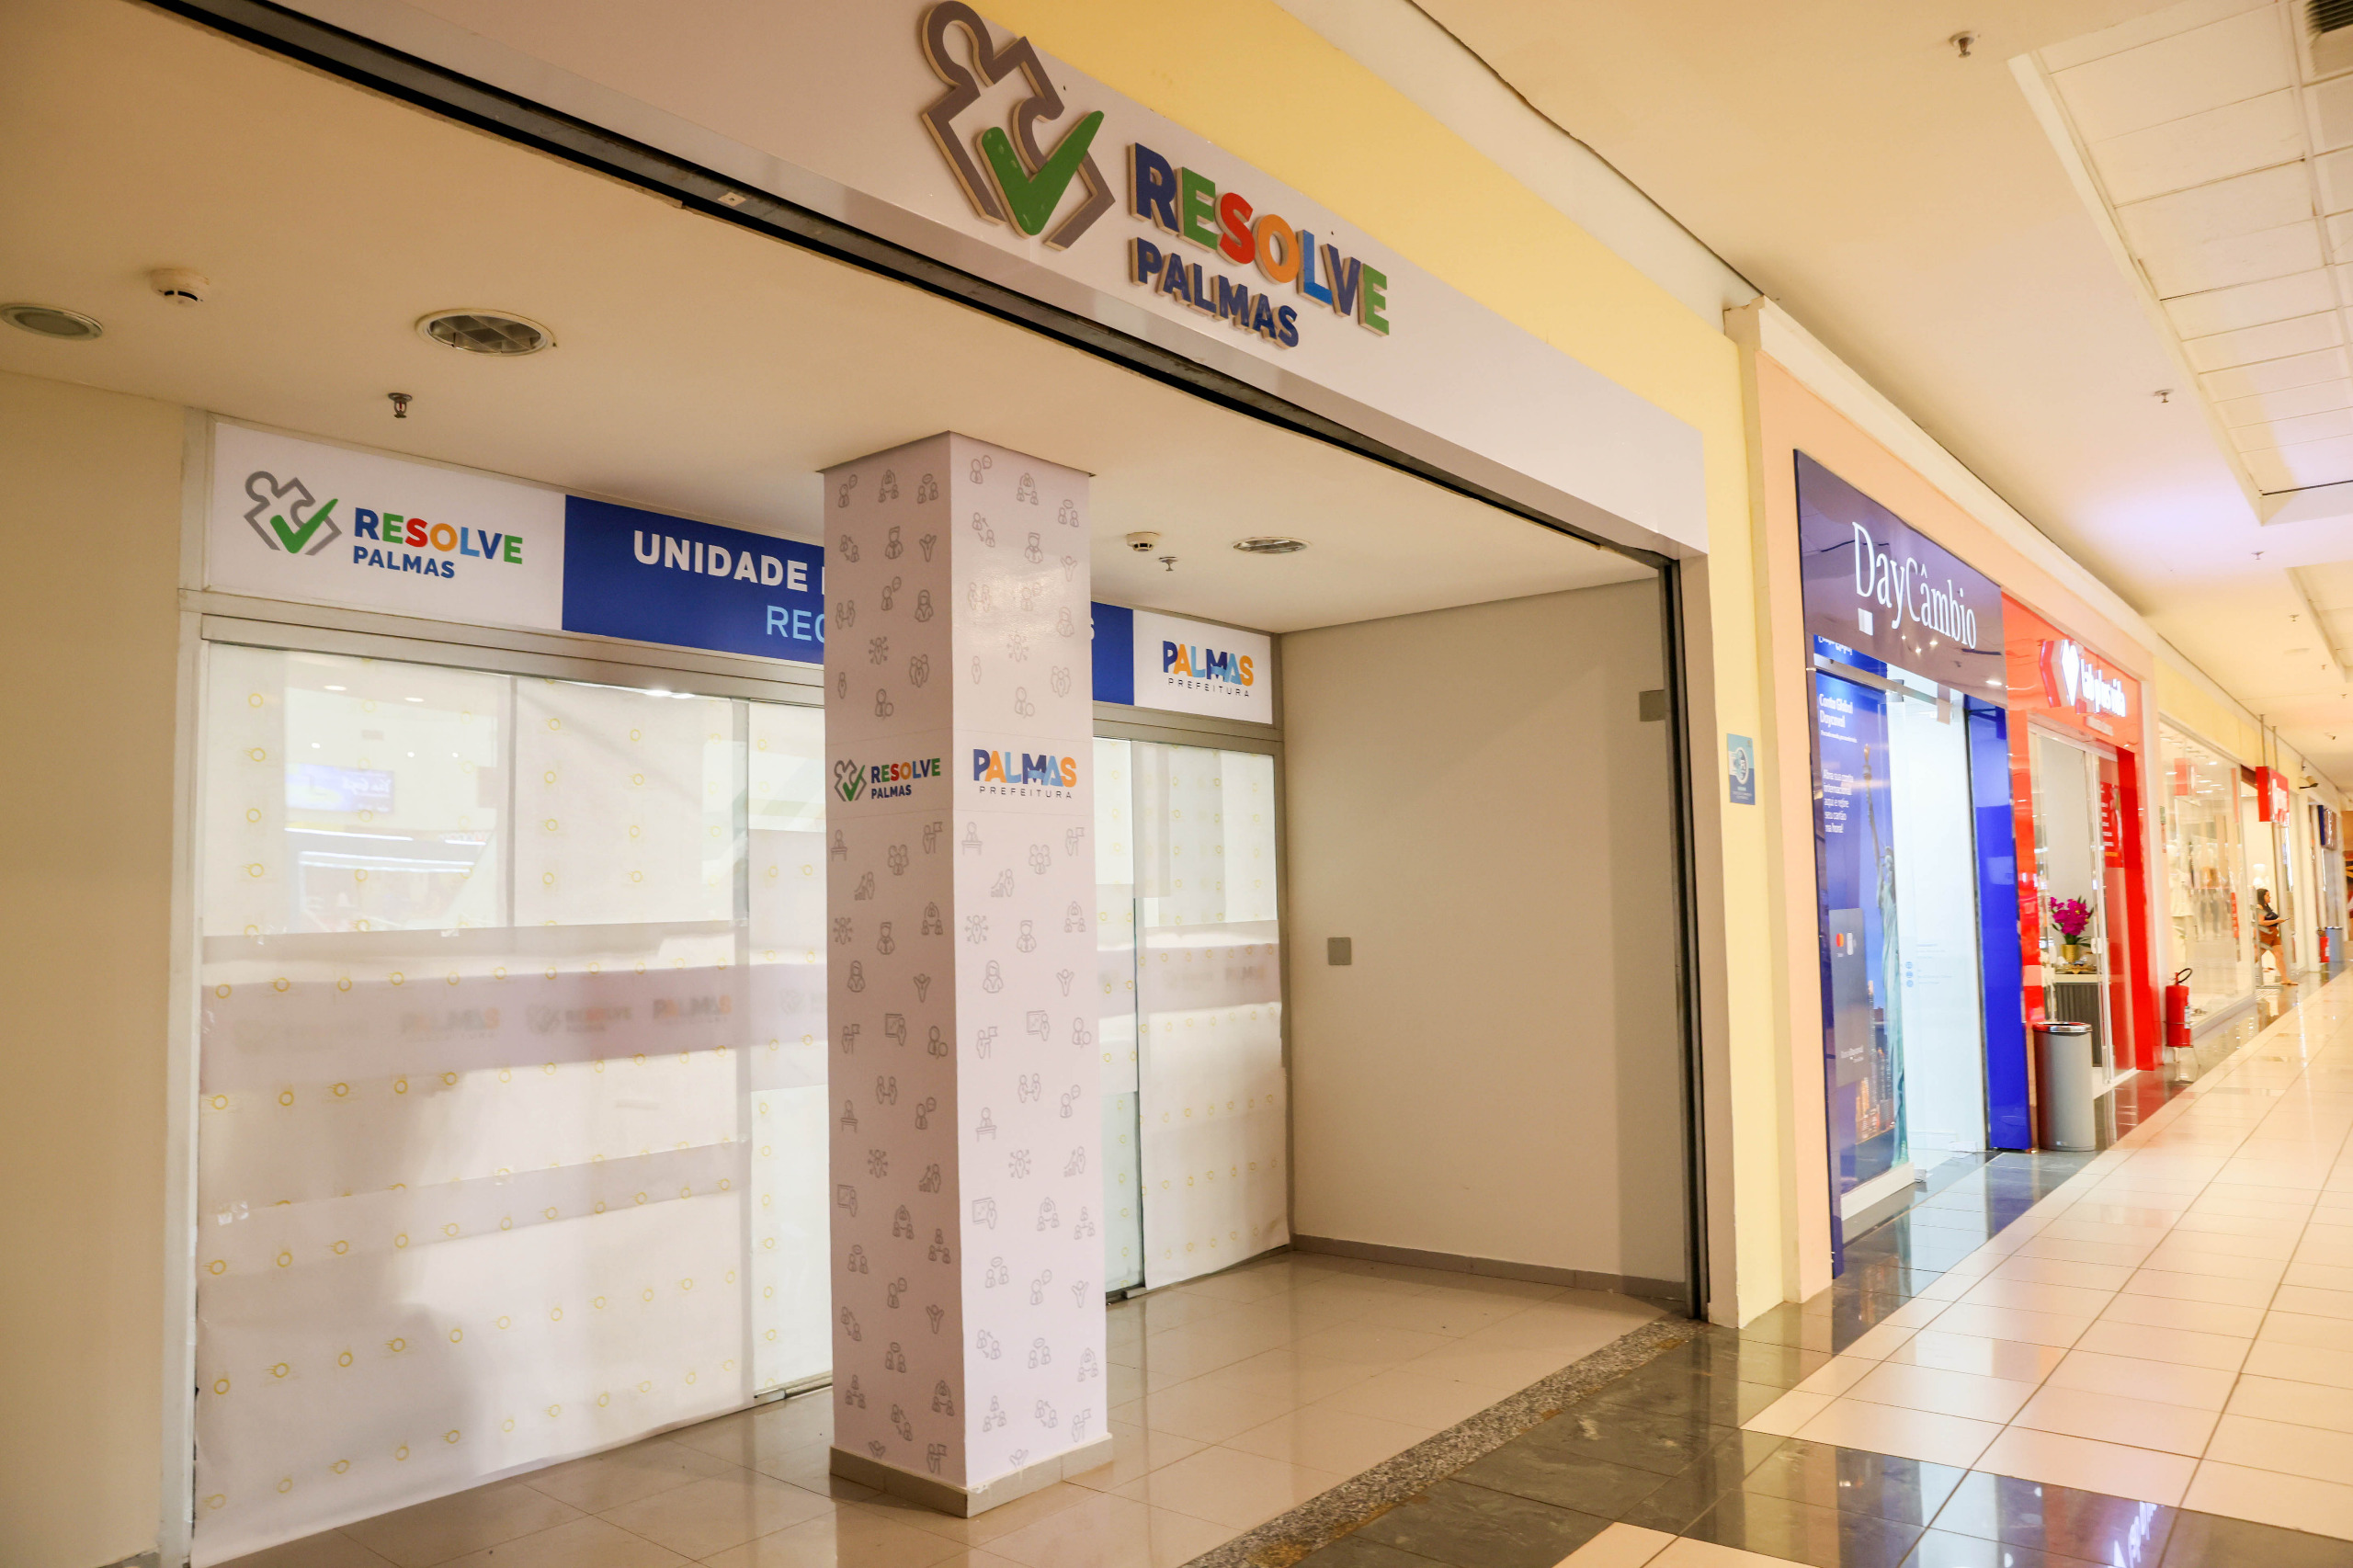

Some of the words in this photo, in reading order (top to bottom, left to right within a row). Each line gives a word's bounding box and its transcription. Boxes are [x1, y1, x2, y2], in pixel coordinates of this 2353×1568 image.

[1129, 142, 1390, 336] RESOLVE
[1130, 237, 1300, 348] PALMAS
[354, 507, 523, 564] RESOLVE
[353, 545, 455, 579] PALMAS
[633, 529, 808, 593] UNIDADE
[1851, 521, 1977, 650] DayCâmbio
[1163, 640, 1255, 687] PALMAS
[1168, 677, 1250, 699] PREFEITURA
[871, 757, 941, 784] RESOLVE
[972, 748, 1077, 788] PALMAS
[870, 784, 912, 800] PALMAS
[979, 786, 1073, 800] PREFEITURA
